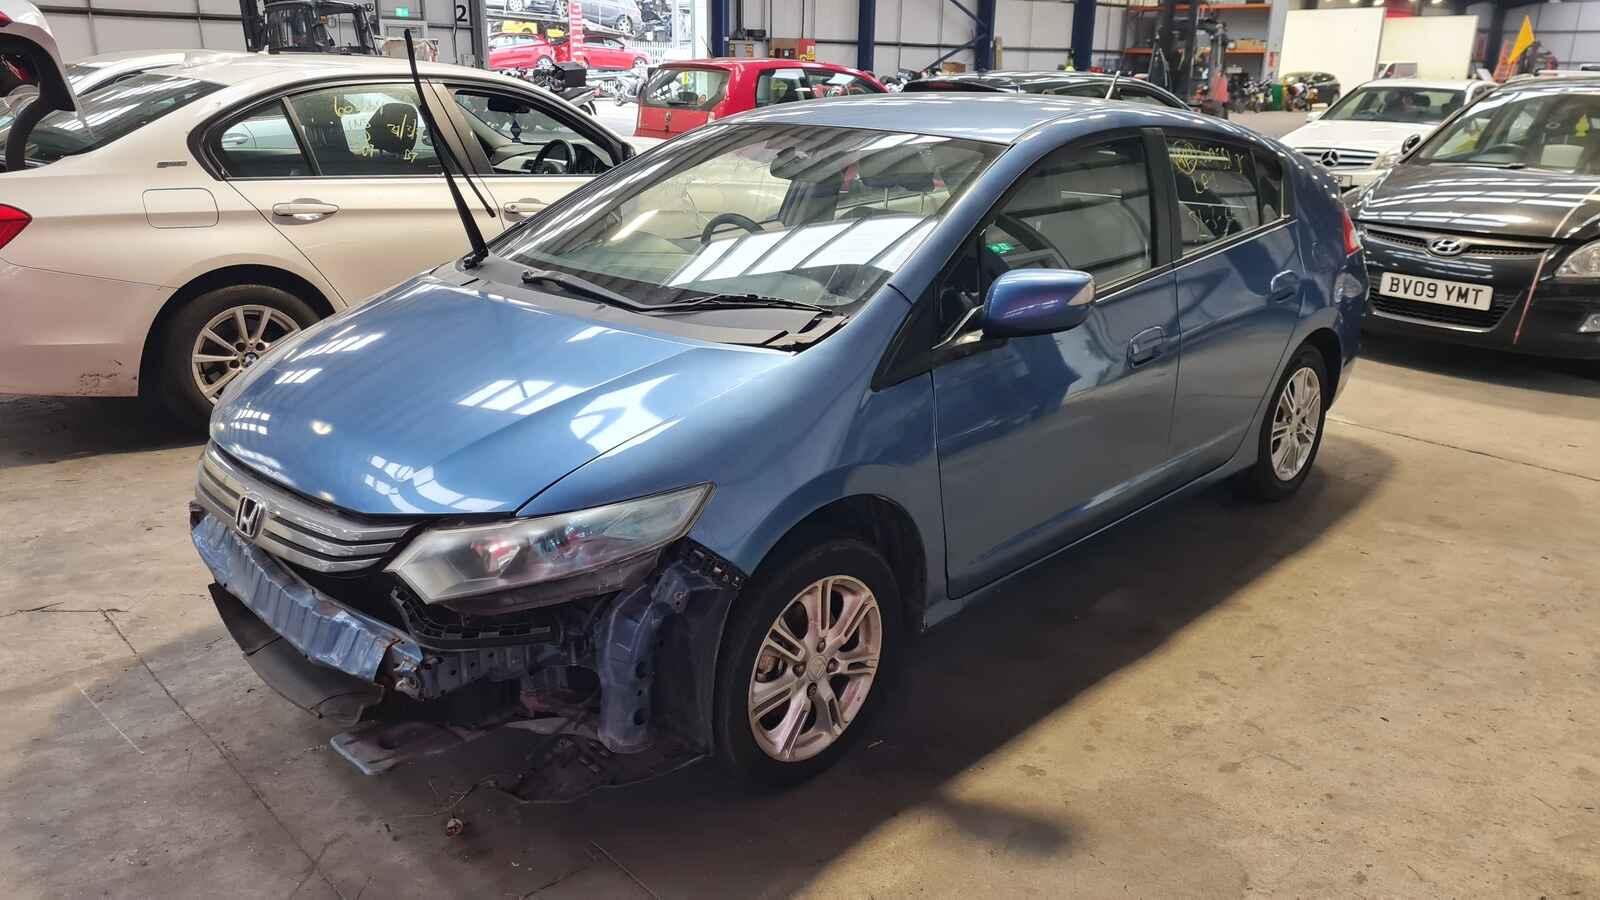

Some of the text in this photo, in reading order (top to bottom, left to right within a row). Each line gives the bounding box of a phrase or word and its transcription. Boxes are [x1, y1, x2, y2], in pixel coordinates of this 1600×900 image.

[456, 5, 468, 22] 2
[1388, 276, 1484, 305] BV09 YMT
